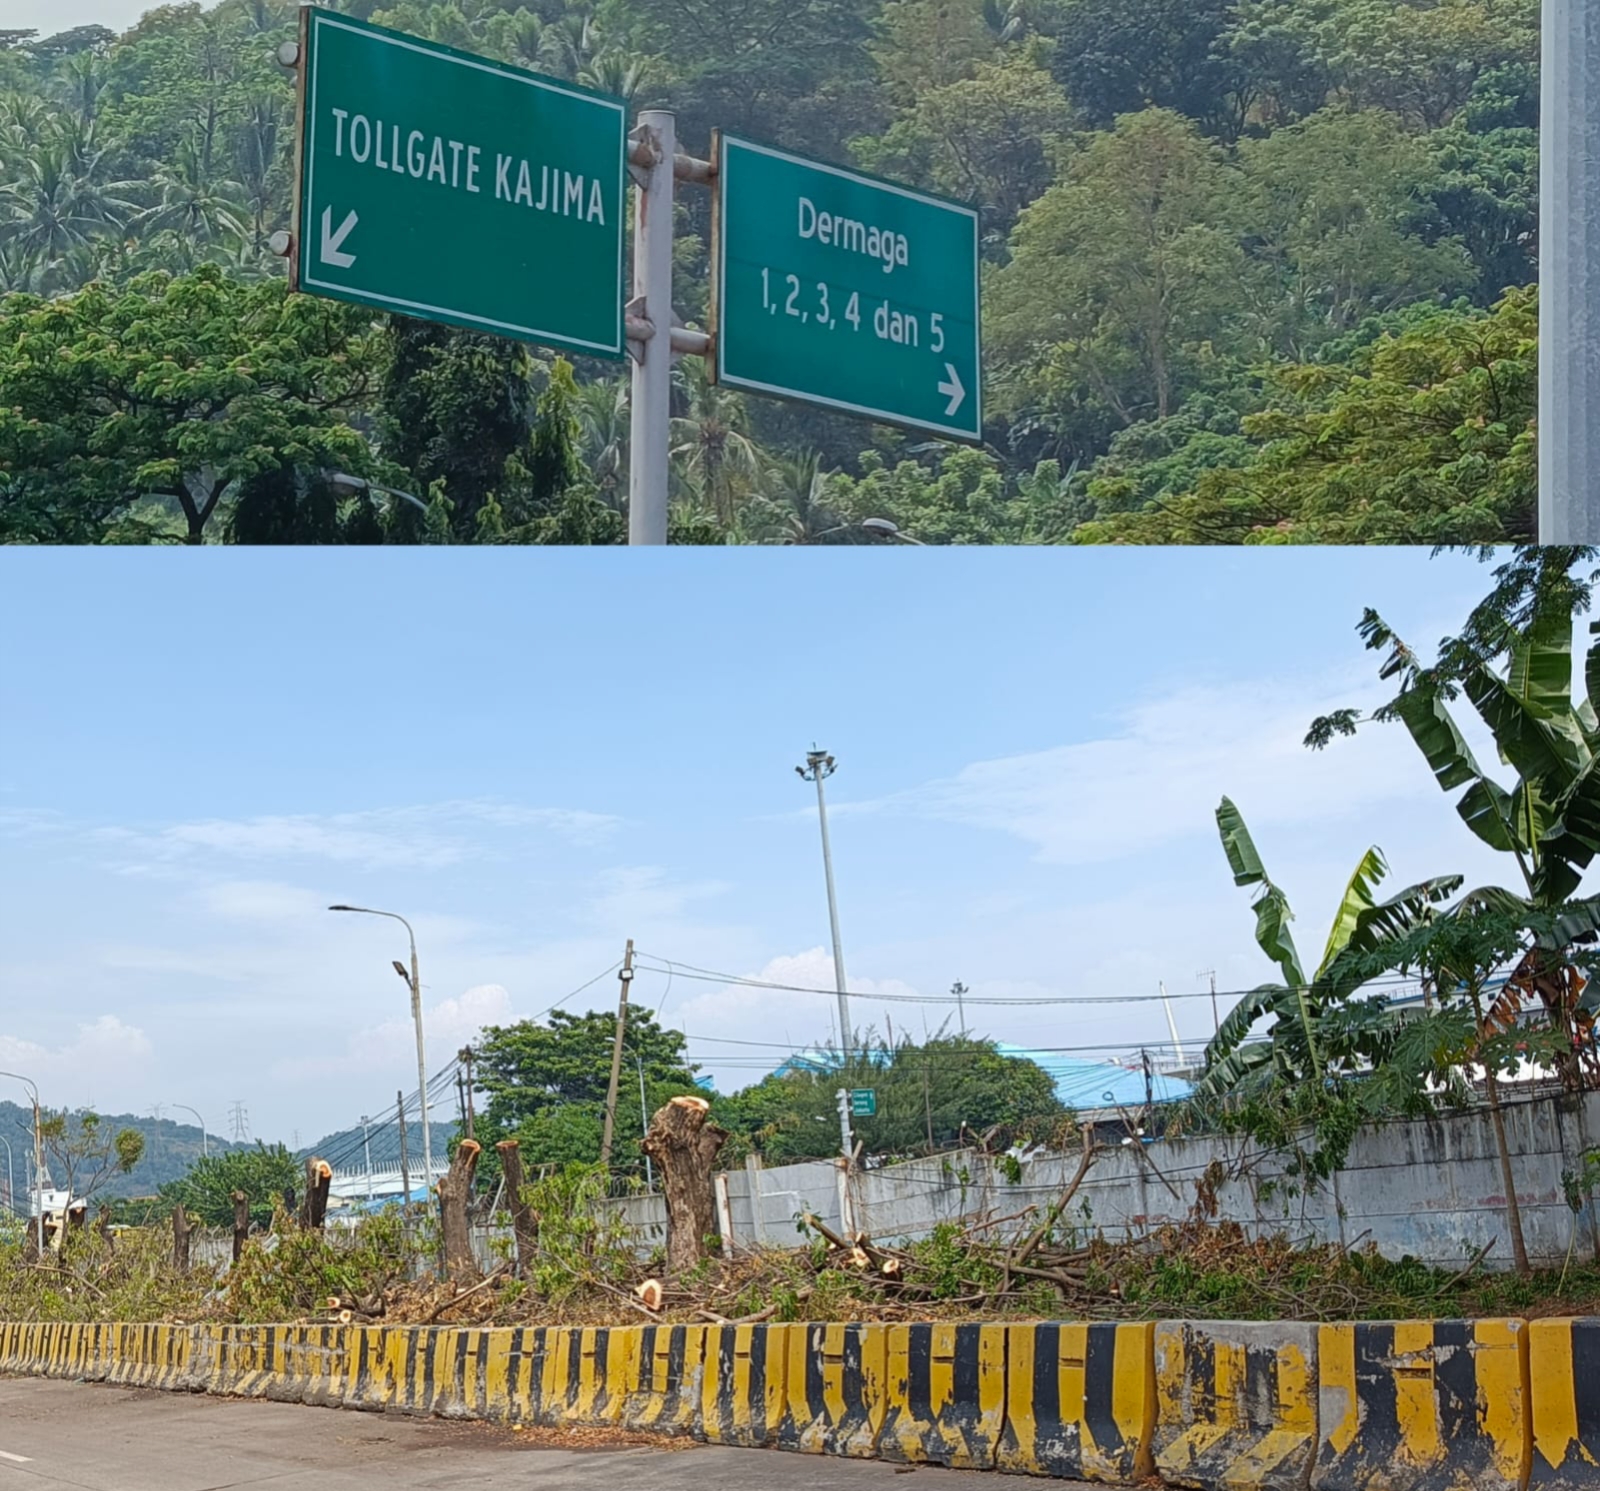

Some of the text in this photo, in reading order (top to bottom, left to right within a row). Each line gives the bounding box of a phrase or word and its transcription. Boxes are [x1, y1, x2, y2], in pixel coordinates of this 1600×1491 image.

[332, 108, 605, 226] TOLLGATE KAJIMA
[798, 197, 908, 273] Dermaga
[762, 267, 945, 354] 1, 2, 3, 4 dan 5
